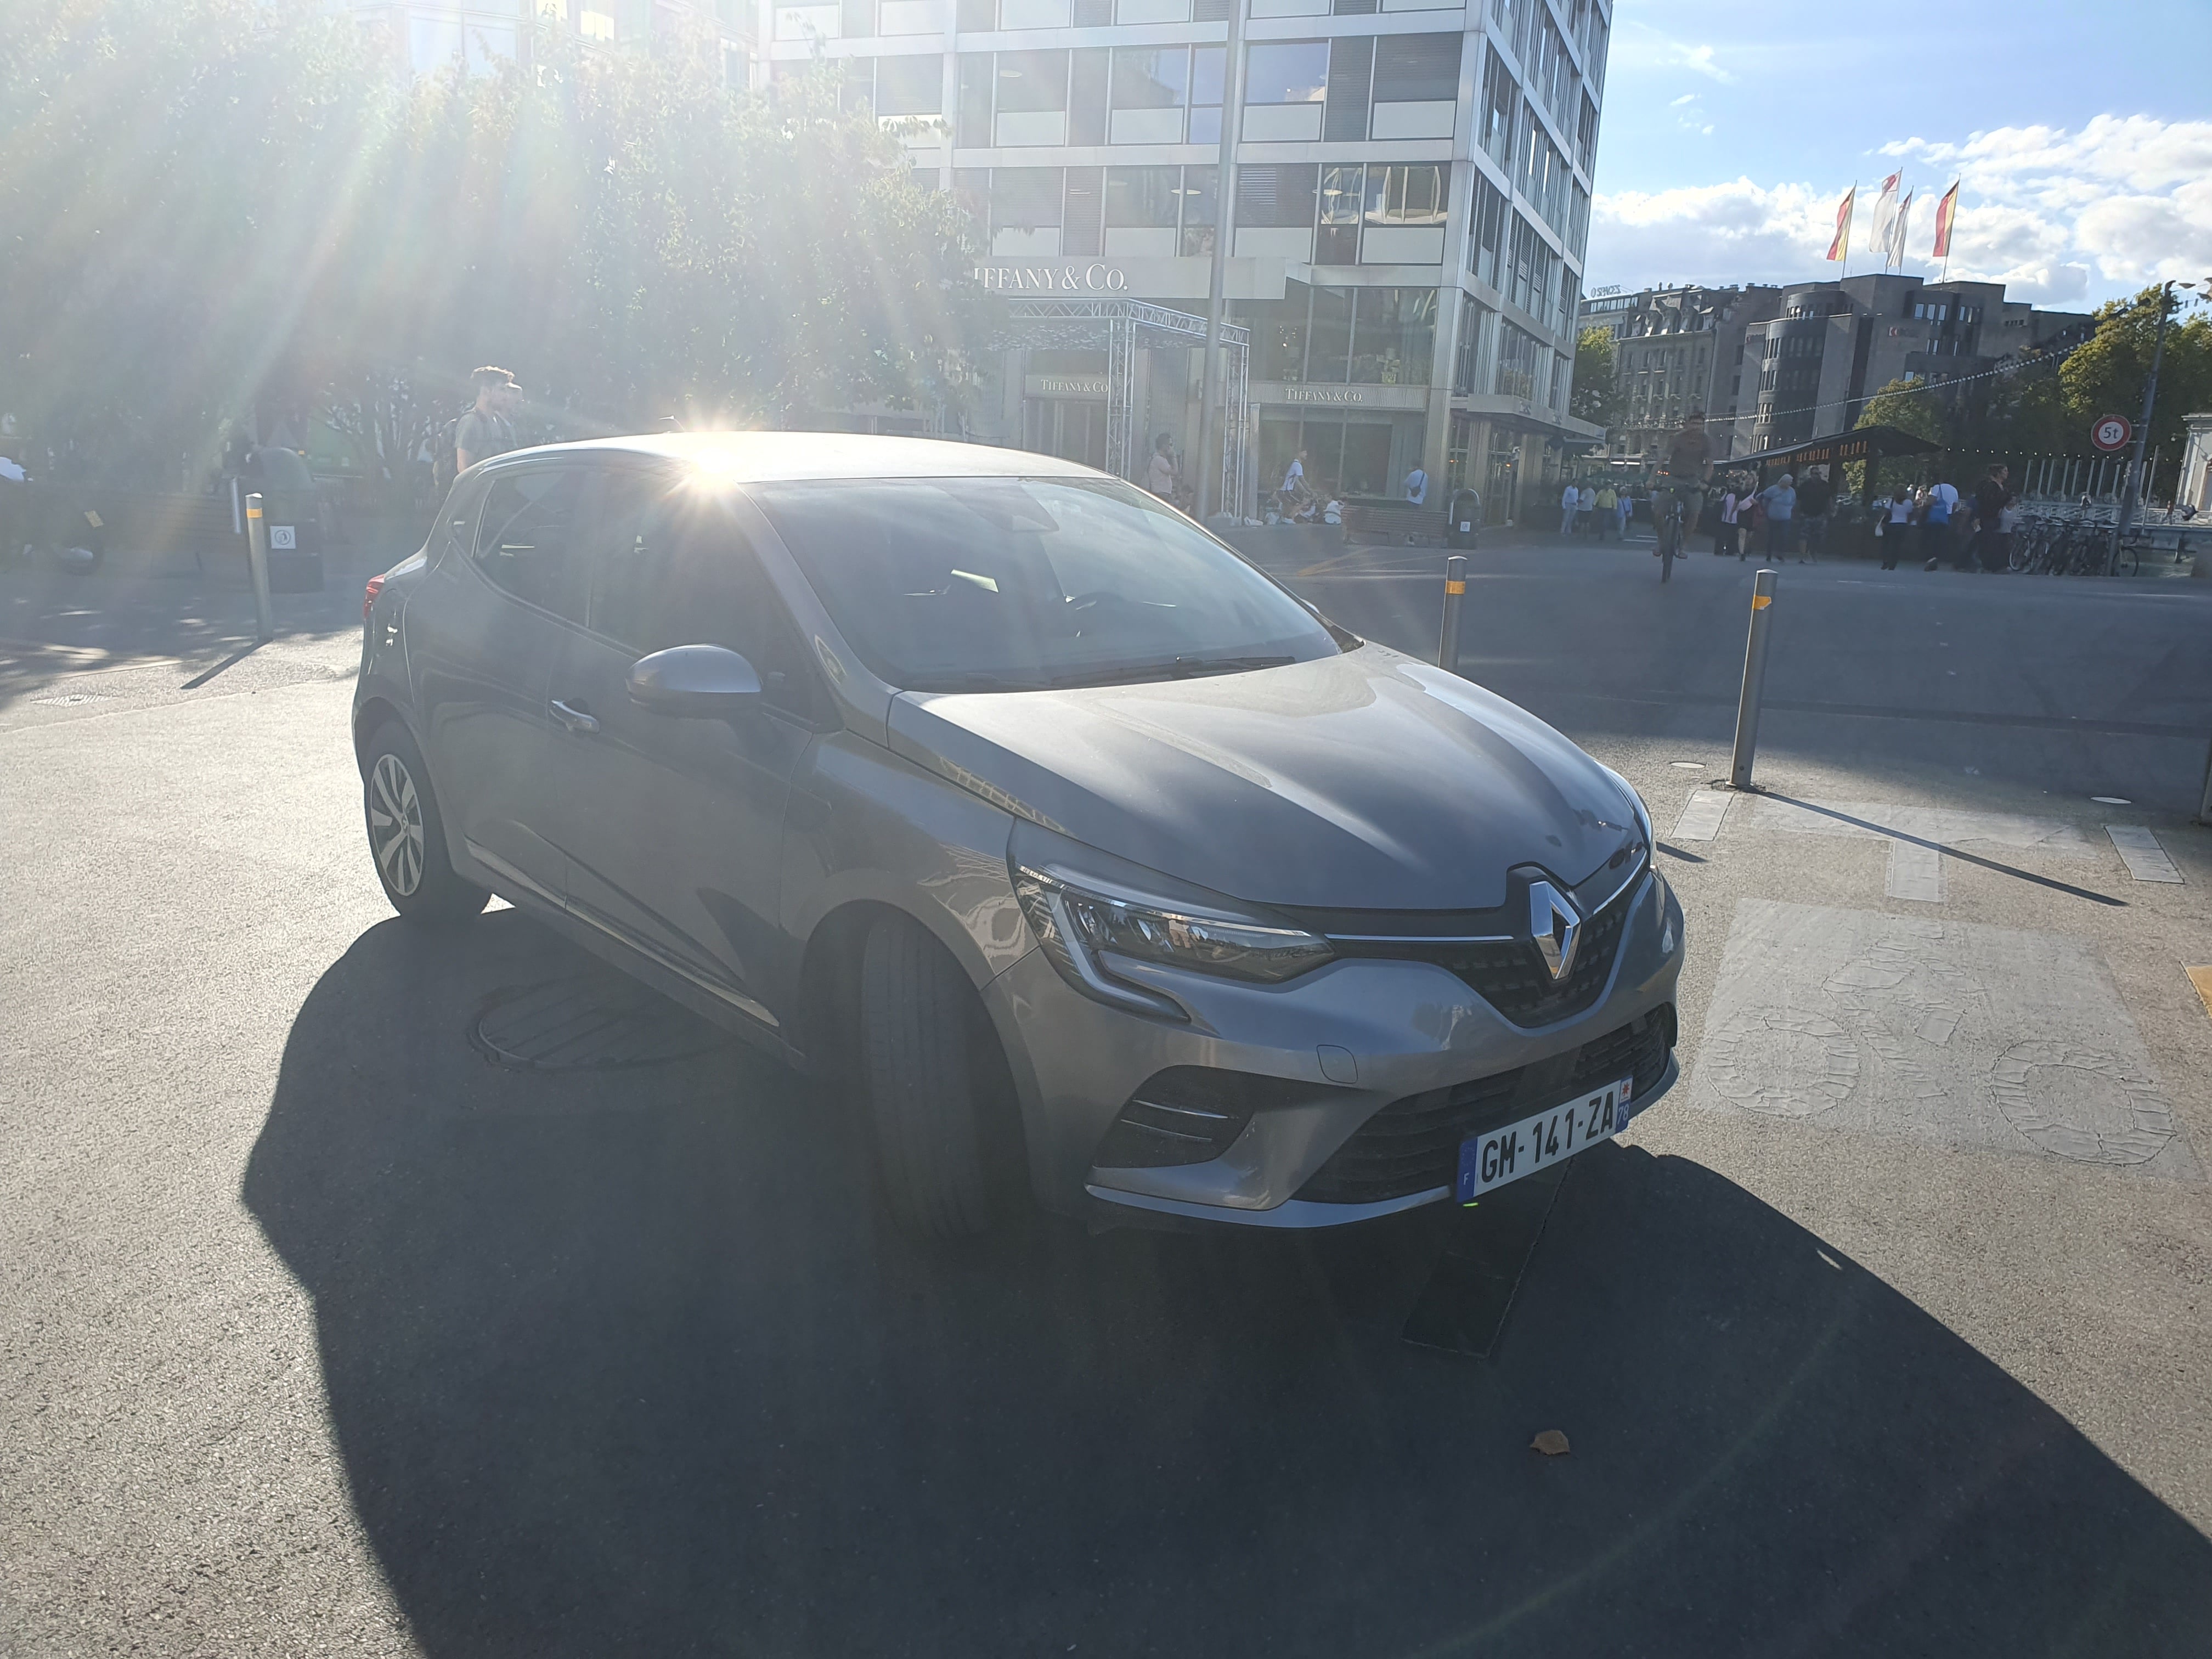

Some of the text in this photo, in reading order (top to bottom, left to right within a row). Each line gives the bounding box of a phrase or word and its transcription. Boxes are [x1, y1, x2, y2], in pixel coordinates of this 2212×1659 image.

[974, 267, 1059, 290] IFFANY
[1061, 265, 1081, 290] &
[1040, 379, 1082, 392] TIFFANY
[1093, 381, 1108, 393] CO
[1285, 388, 1333, 401] TIFFANY
[2103, 427, 2118, 439] 5t
[1463, 1091, 1629, 1186] F GM-141-ZA 78
